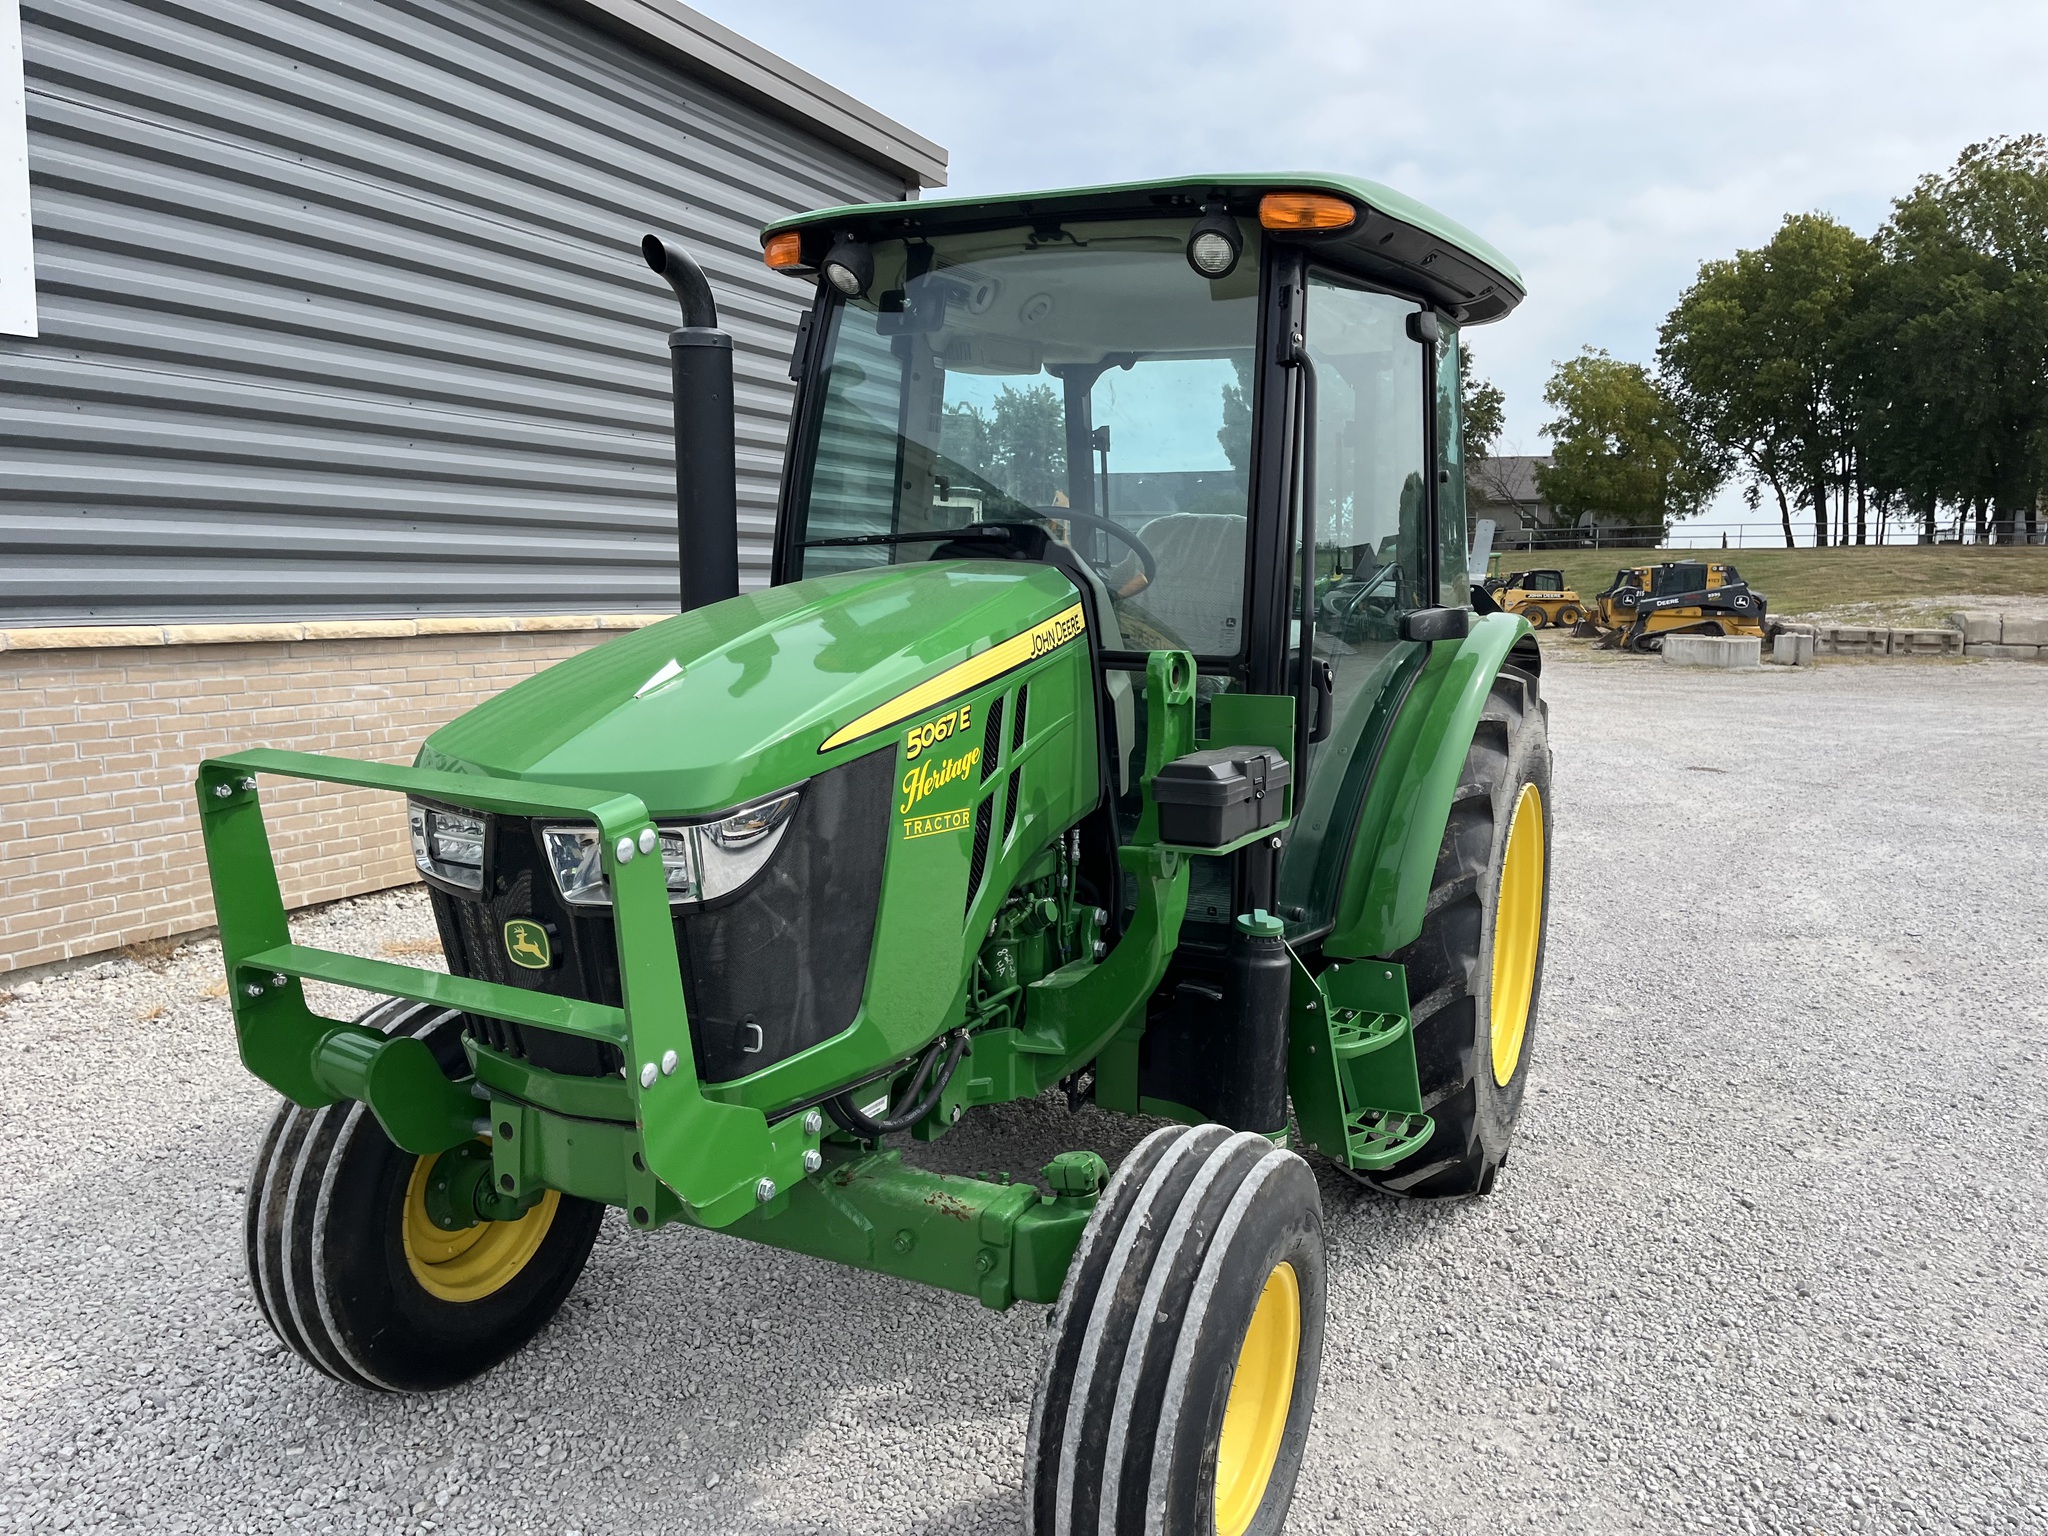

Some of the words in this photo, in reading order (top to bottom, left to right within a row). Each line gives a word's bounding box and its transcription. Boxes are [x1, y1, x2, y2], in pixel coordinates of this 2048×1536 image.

[1656, 598, 1679, 607] DEERE
[1031, 627, 1056, 656] JOHN
[1055, 613, 1081, 642] DEERE
[900, 747, 981, 814] Heritage
[903, 811, 970, 836] TRACTOR
